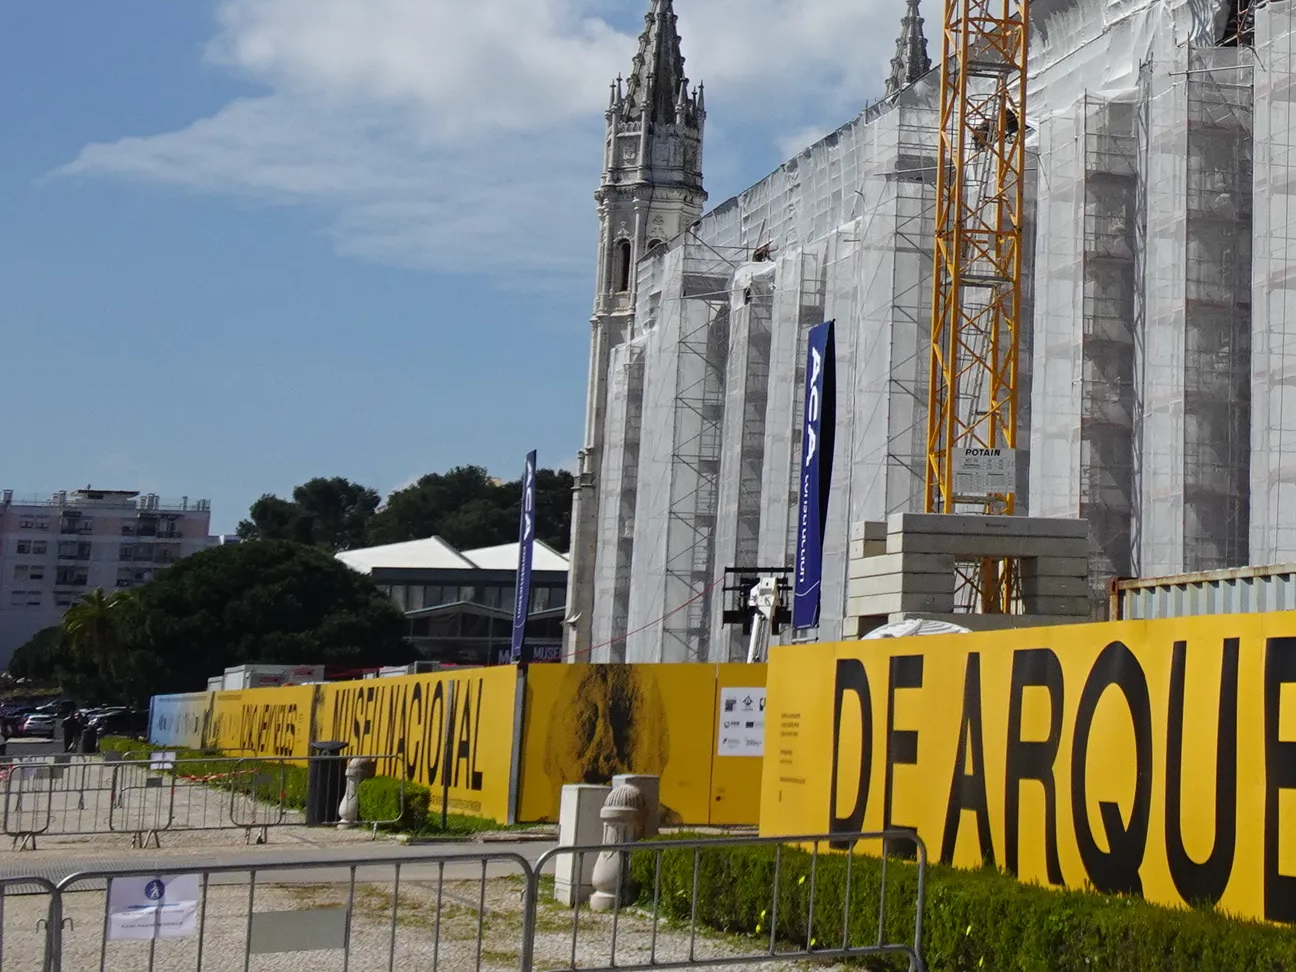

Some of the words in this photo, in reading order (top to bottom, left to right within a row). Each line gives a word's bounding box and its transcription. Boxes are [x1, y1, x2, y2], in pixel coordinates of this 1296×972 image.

[805, 346, 821, 468] ACA
[965, 448, 1001, 457] POTAIN
[331, 686, 385, 774] MUSEU
[382, 677, 484, 791] NACIONAL
[829, 653, 924, 860] DE
